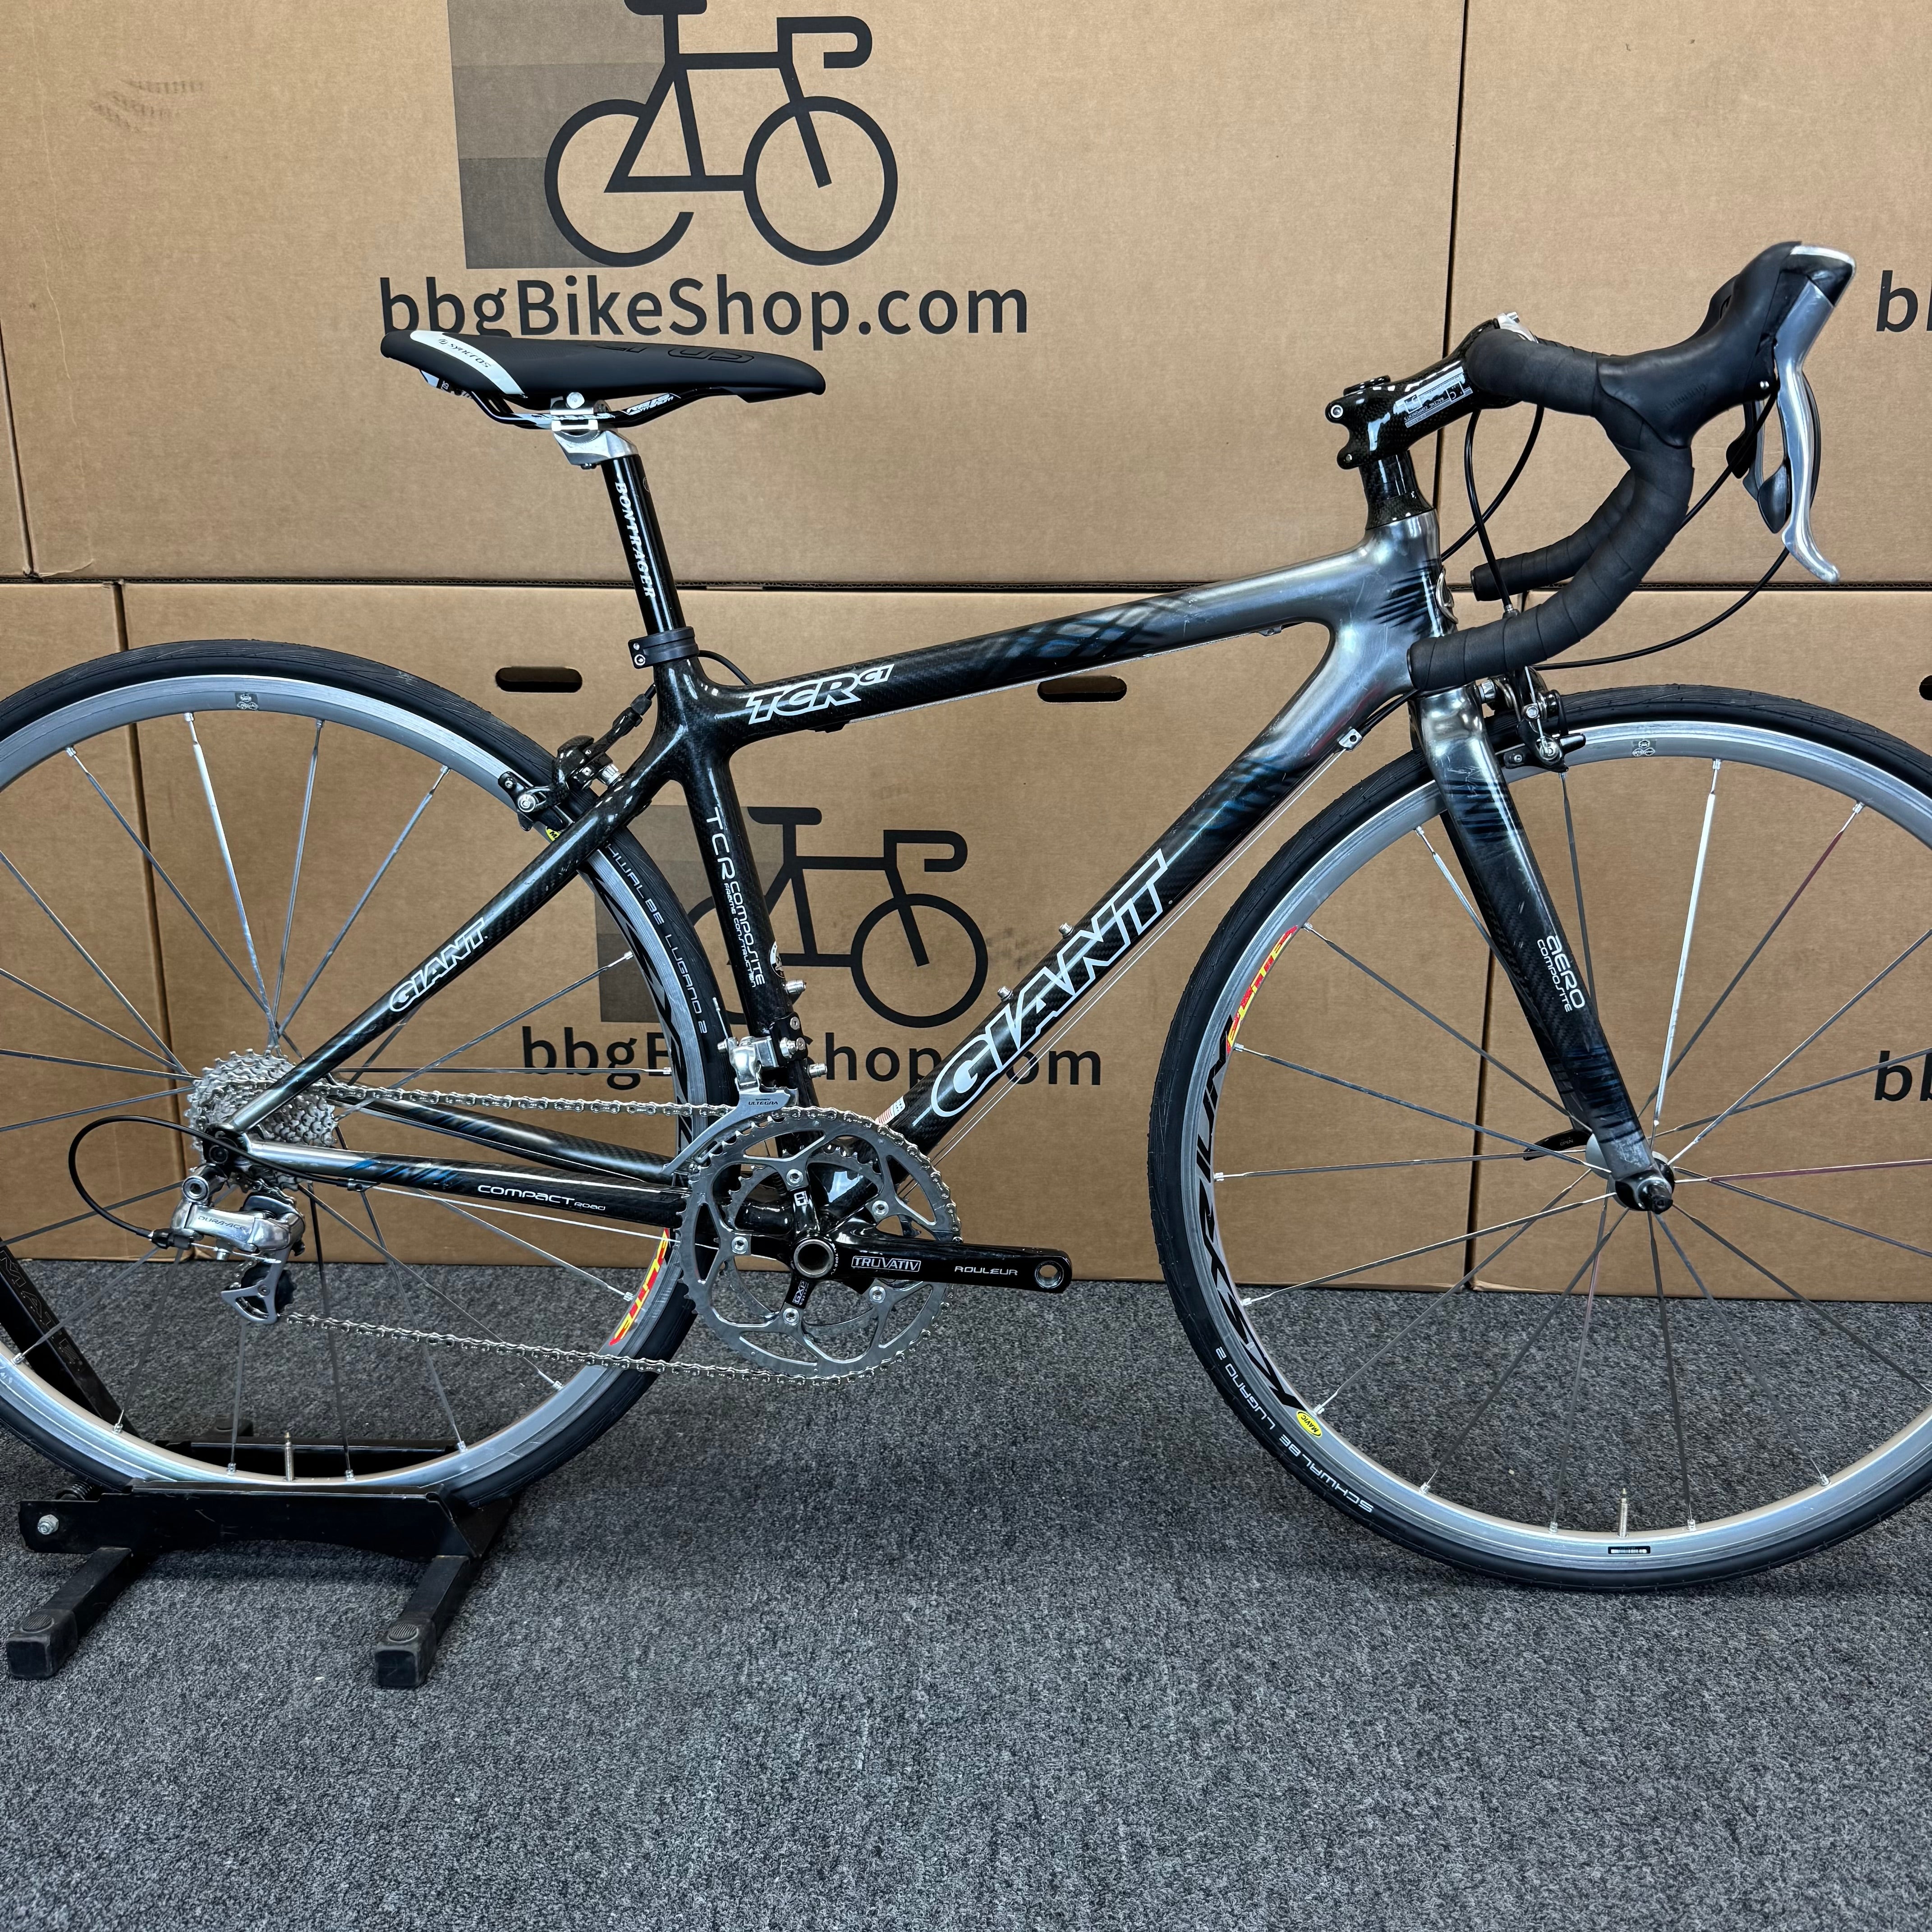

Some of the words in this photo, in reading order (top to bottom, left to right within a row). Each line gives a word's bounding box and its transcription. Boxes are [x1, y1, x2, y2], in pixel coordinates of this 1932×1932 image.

[380, 274, 1028, 351] bbgBikeShop.com
[1876, 270, 1932, 332] b
[614, 480, 657, 599] BONTRAGER
[745, 672, 861, 725] TCR
[706, 806, 736, 880] TCR
[730, 881, 765, 986] COMPOSITE
[389, 917, 485, 1012] GIANT
[665, 934, 702, 1014] LUGANO
[698, 1020, 708, 1034] 2
[931, 848, 1168, 1117] GIANT
[1537, 939, 1573, 1012] COMPOSITE
[1546, 935, 1585, 1008] AERO
[1874, 1050, 1932, 1101] b
[198, 1215, 248, 1230] DURA-ACE
[477, 1184, 575, 1205] COMPACT
[793, 1280, 806, 1303] GXP
[852, 1256, 920, 1271] TRUVATIV
[954, 1265, 1018, 1276] ROULEUR
[1215, 1346, 1227, 1361] 2
[1224, 1363, 1276, 1431] LUGANO
[1301, 1415, 1319, 1433] MAVIC
[1279, 1434, 1374, 1513] SCHWALBE
